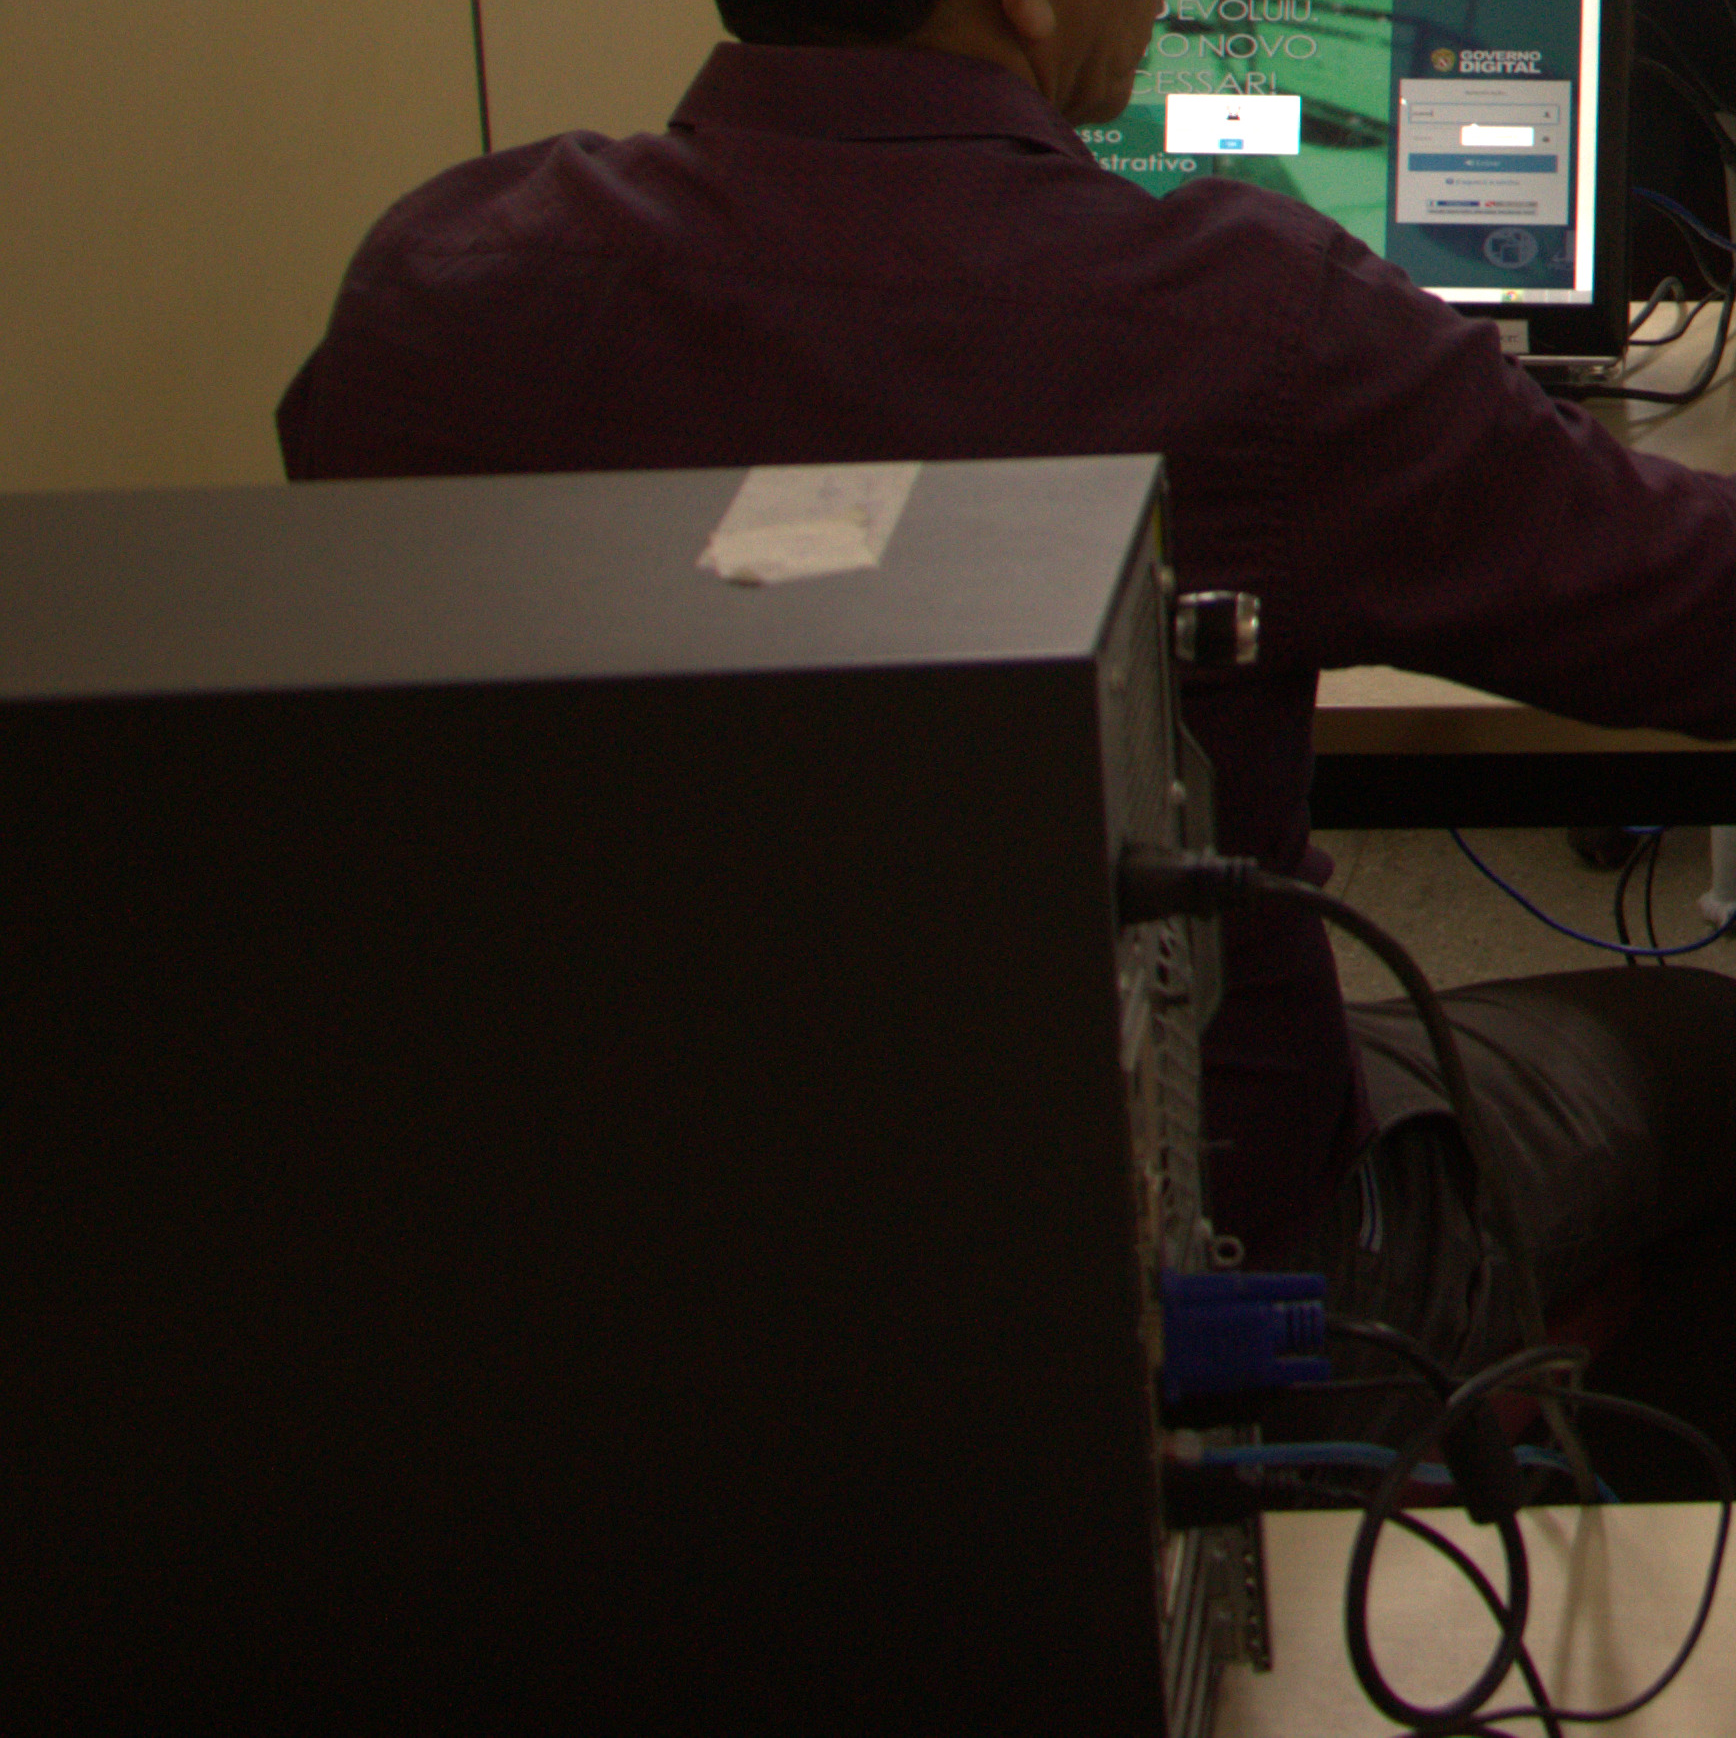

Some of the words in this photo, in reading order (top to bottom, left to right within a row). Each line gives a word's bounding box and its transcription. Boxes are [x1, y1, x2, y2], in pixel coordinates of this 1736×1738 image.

[1157, 32, 1190, 58] O
[1199, 33, 1317, 59] NOVO
[1459, 50, 1541, 61] GOVERNO
[1459, 60, 1541, 73] DIGITAL
